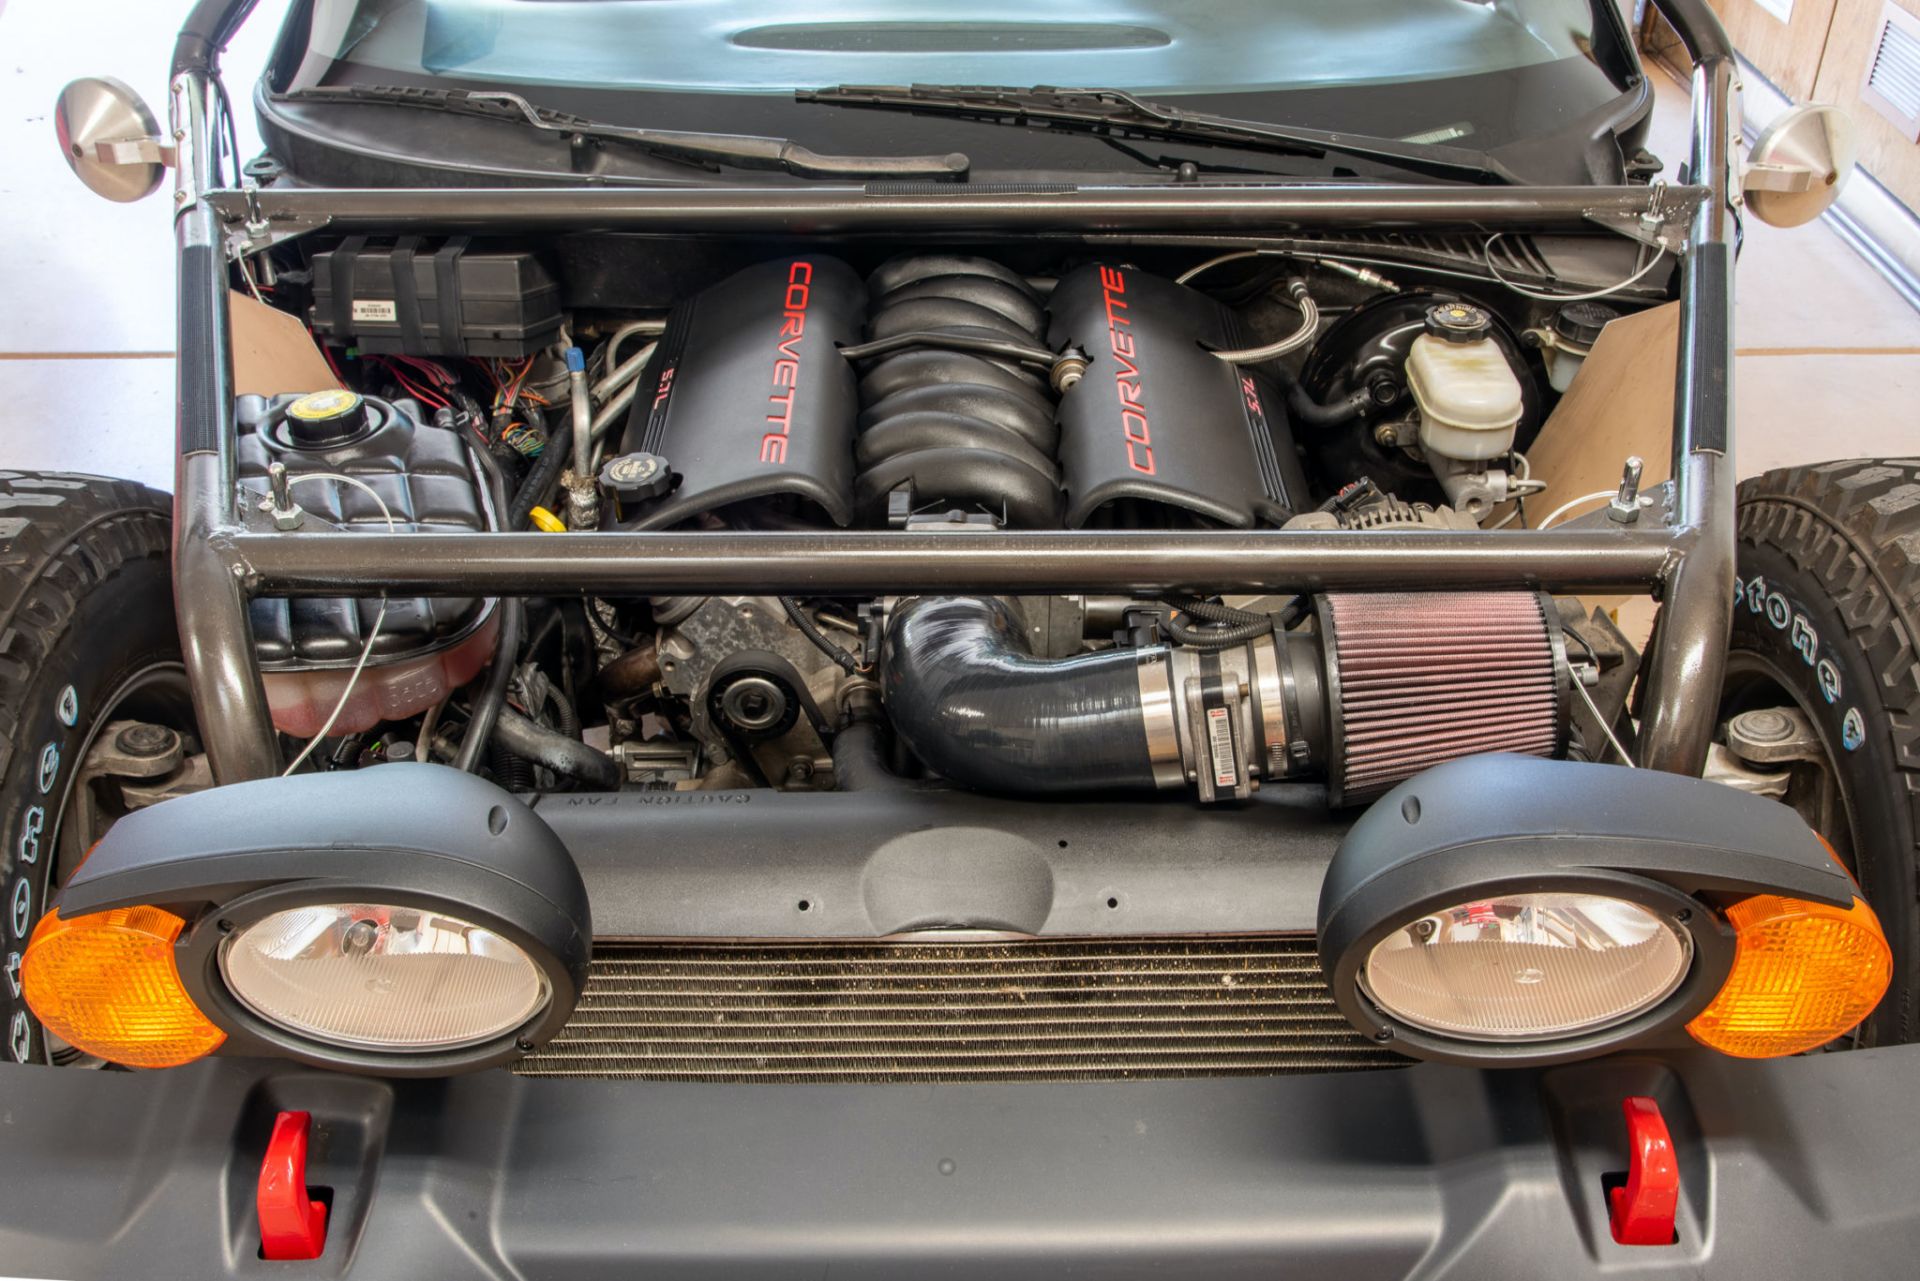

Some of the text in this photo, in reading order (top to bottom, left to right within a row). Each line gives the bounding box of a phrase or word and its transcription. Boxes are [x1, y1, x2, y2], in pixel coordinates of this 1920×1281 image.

[759, 262, 813, 465] CORVETTE
[1100, 265, 1156, 475] CORVETTE
[653, 367, 675, 410] 5.7L
[1241, 377, 1262, 417] 5.7L
[567, 794, 751, 807] CAUTION FAN
